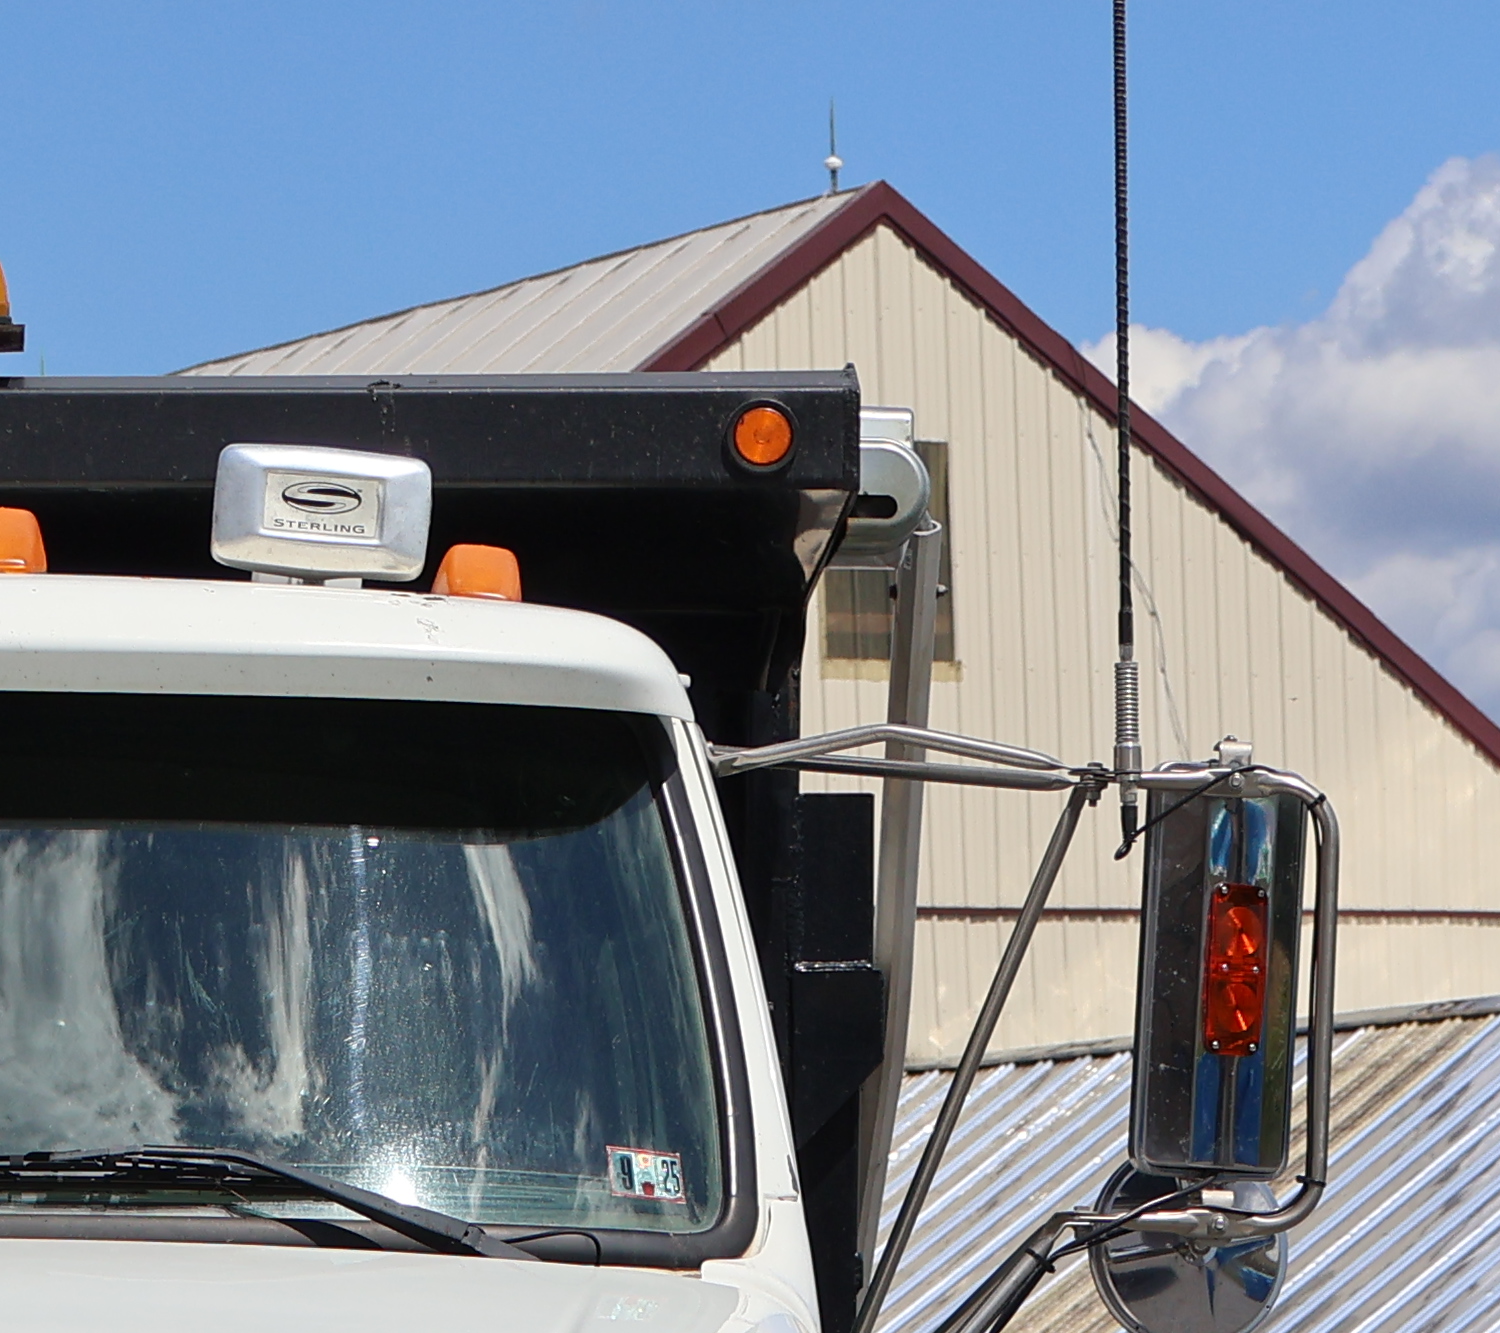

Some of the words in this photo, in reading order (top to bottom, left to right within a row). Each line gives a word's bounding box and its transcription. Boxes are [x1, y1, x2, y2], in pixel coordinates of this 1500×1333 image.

[273, 518, 365, 534] STERLING
[620, 1156, 633, 1190] 9
[661, 1159, 680, 1193] 25
